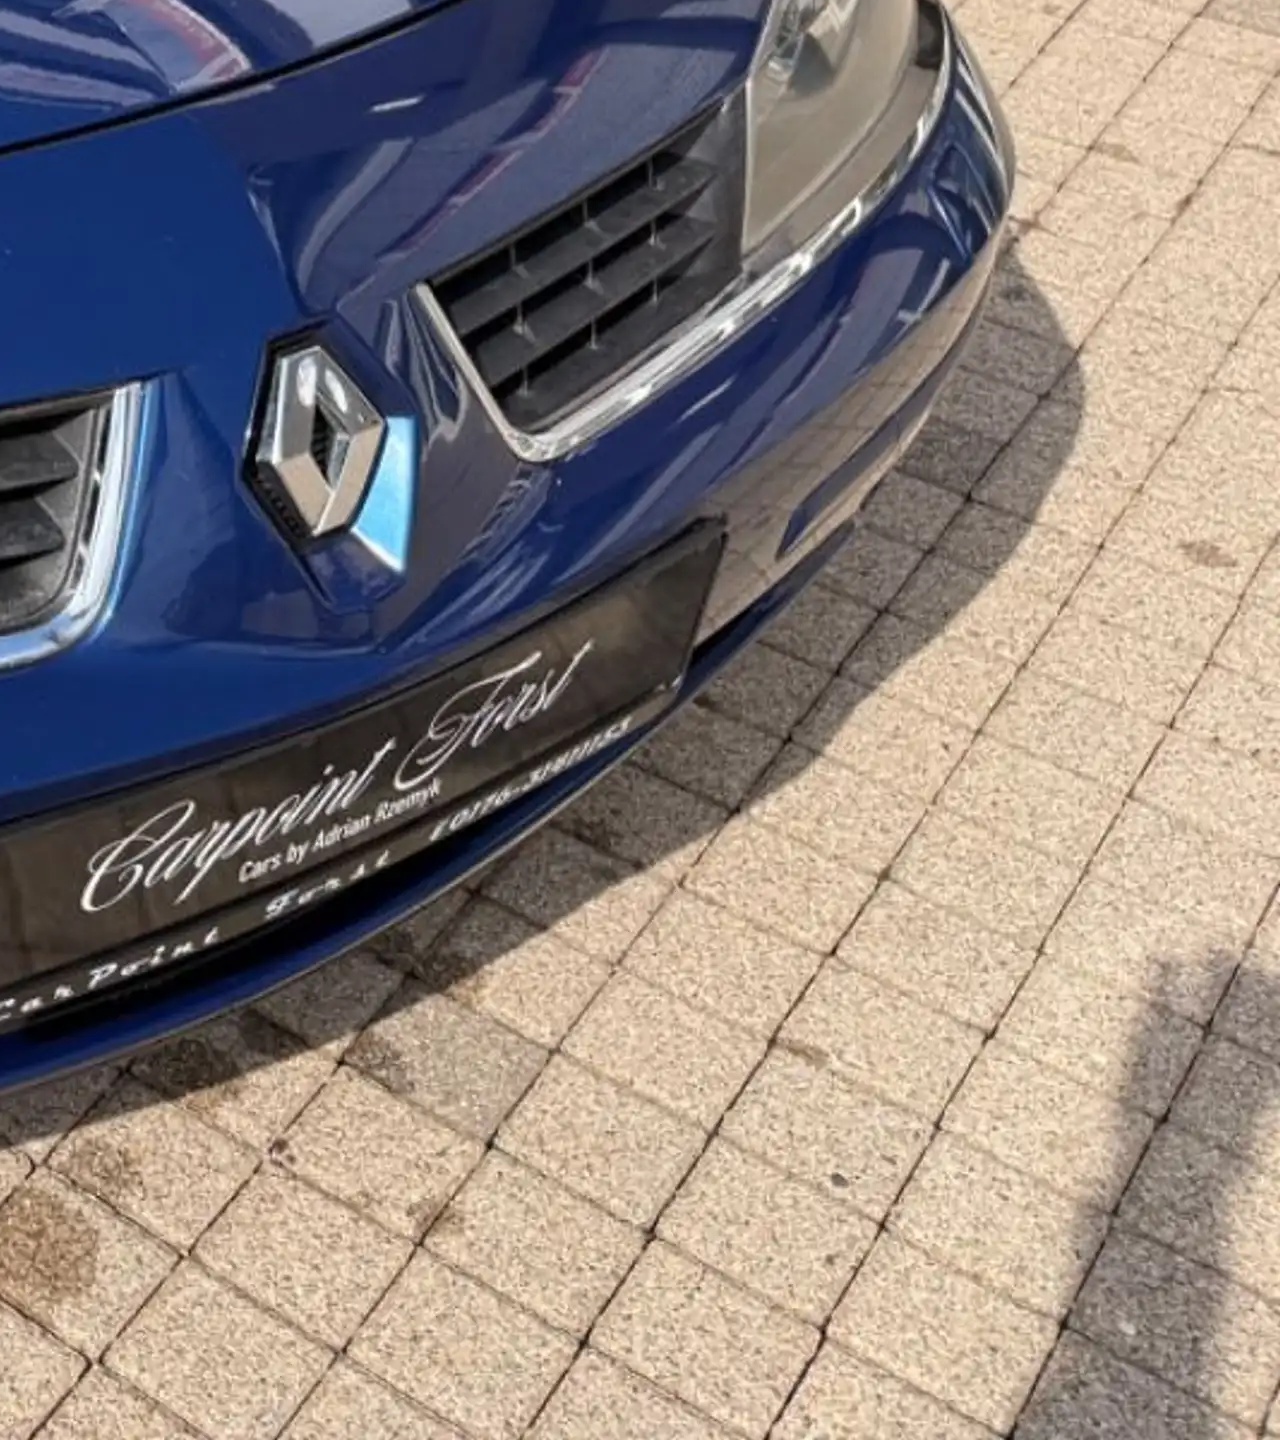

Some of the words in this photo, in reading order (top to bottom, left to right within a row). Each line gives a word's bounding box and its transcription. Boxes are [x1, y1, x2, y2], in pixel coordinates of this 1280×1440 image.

[80, 736, 396, 912] Carpoint
[394, 638, 594, 791] Forst
[239, 853, 282, 883] Cars
[286, 840, 310, 864] by
[311, 814, 372, 852] Adrian
[373, 777, 442, 823] Rzemyk
